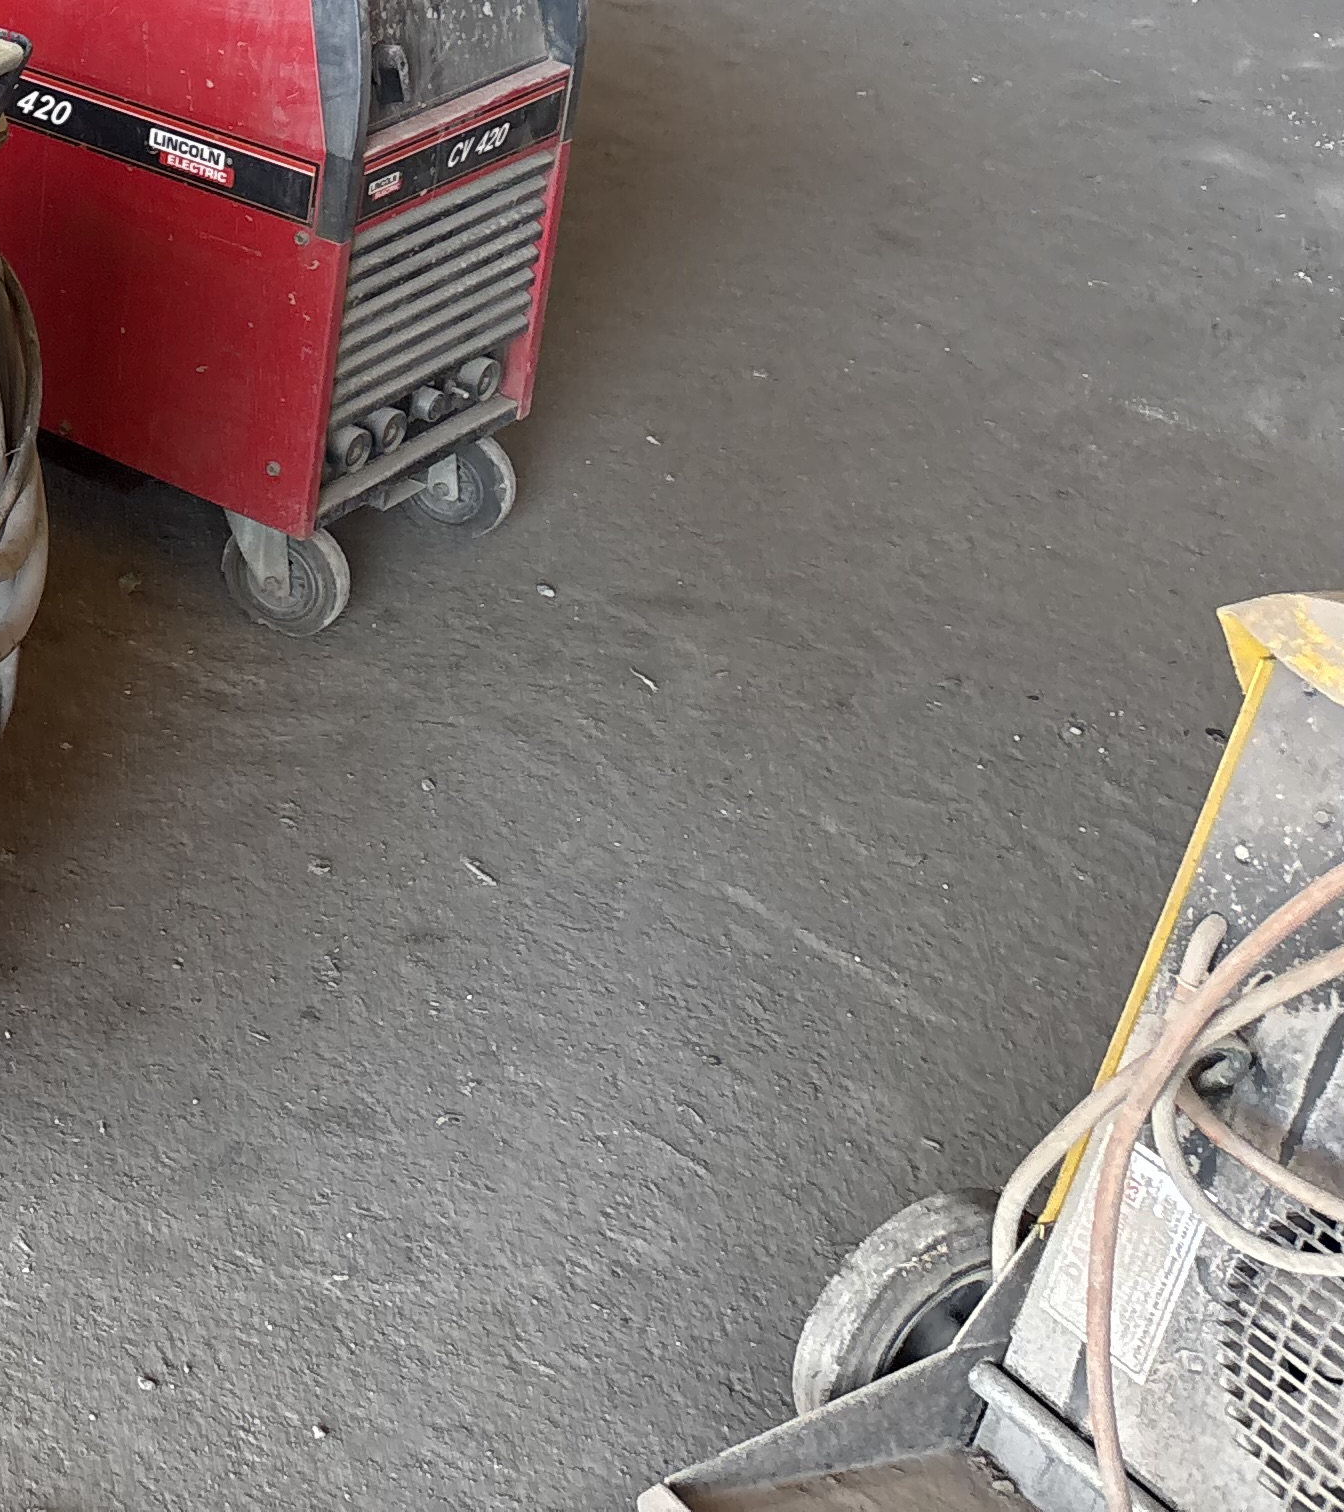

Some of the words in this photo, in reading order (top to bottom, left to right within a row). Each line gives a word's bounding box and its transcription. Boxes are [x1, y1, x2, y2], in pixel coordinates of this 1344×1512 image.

[16, 90, 73, 126] 420
[153, 130, 221, 166] LINCOLN
[447, 136, 475, 168] CV
[475, 122, 511, 155] 420
[166, 153, 228, 183] ELECTRIC
